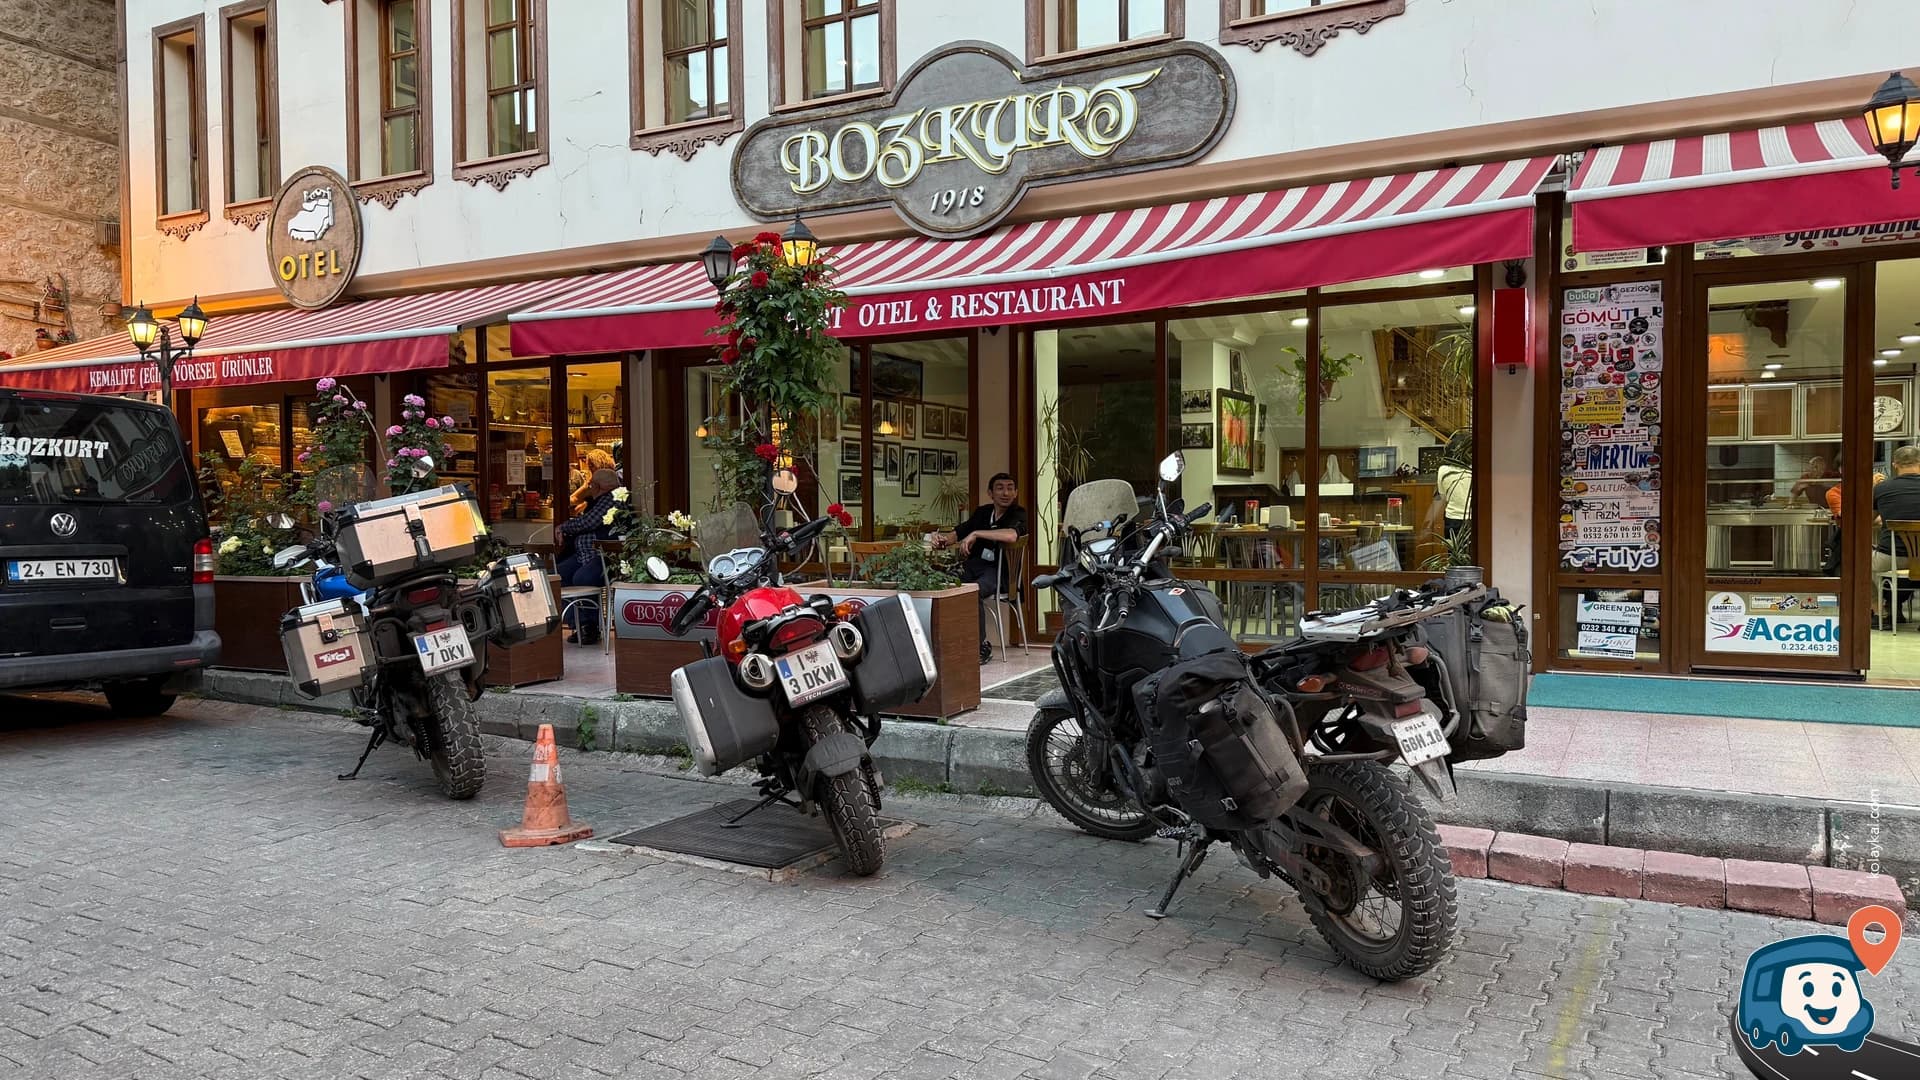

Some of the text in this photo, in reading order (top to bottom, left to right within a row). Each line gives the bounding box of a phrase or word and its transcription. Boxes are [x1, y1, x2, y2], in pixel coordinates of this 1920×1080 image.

[781, 67, 1163, 194] BOZKURT
[929, 185, 985, 215] 1918
[280, 250, 341, 281] OTEL
[858, 295, 917, 328] OTEL
[924, 294, 943, 321] &
[950, 279, 1126, 317] RESTAURANT
[90, 356, 273, 389] KEMALİYE (EĞİ YÖRESEL ÜRÜNLER
[0, 436, 109, 459] BOZKURT
[1590, 483, 1627, 493] SALTUR
[23, 563, 45, 577] 24
[56, 562, 76, 577] EN
[81, 561, 110, 576] 730
[1595, 548, 1657, 569] Fulya
[1593, 603, 1641, 613] GREEN DAY
[1581, 623, 1600, 632] 0232
[1617, 625, 1627, 633] 44
[1629, 626, 1639, 634] 40
[426, 643, 465, 667] 7 DKV
[1781, 643, 1838, 652] 0.232.463 25
[789, 663, 837, 695] 3 DKW
